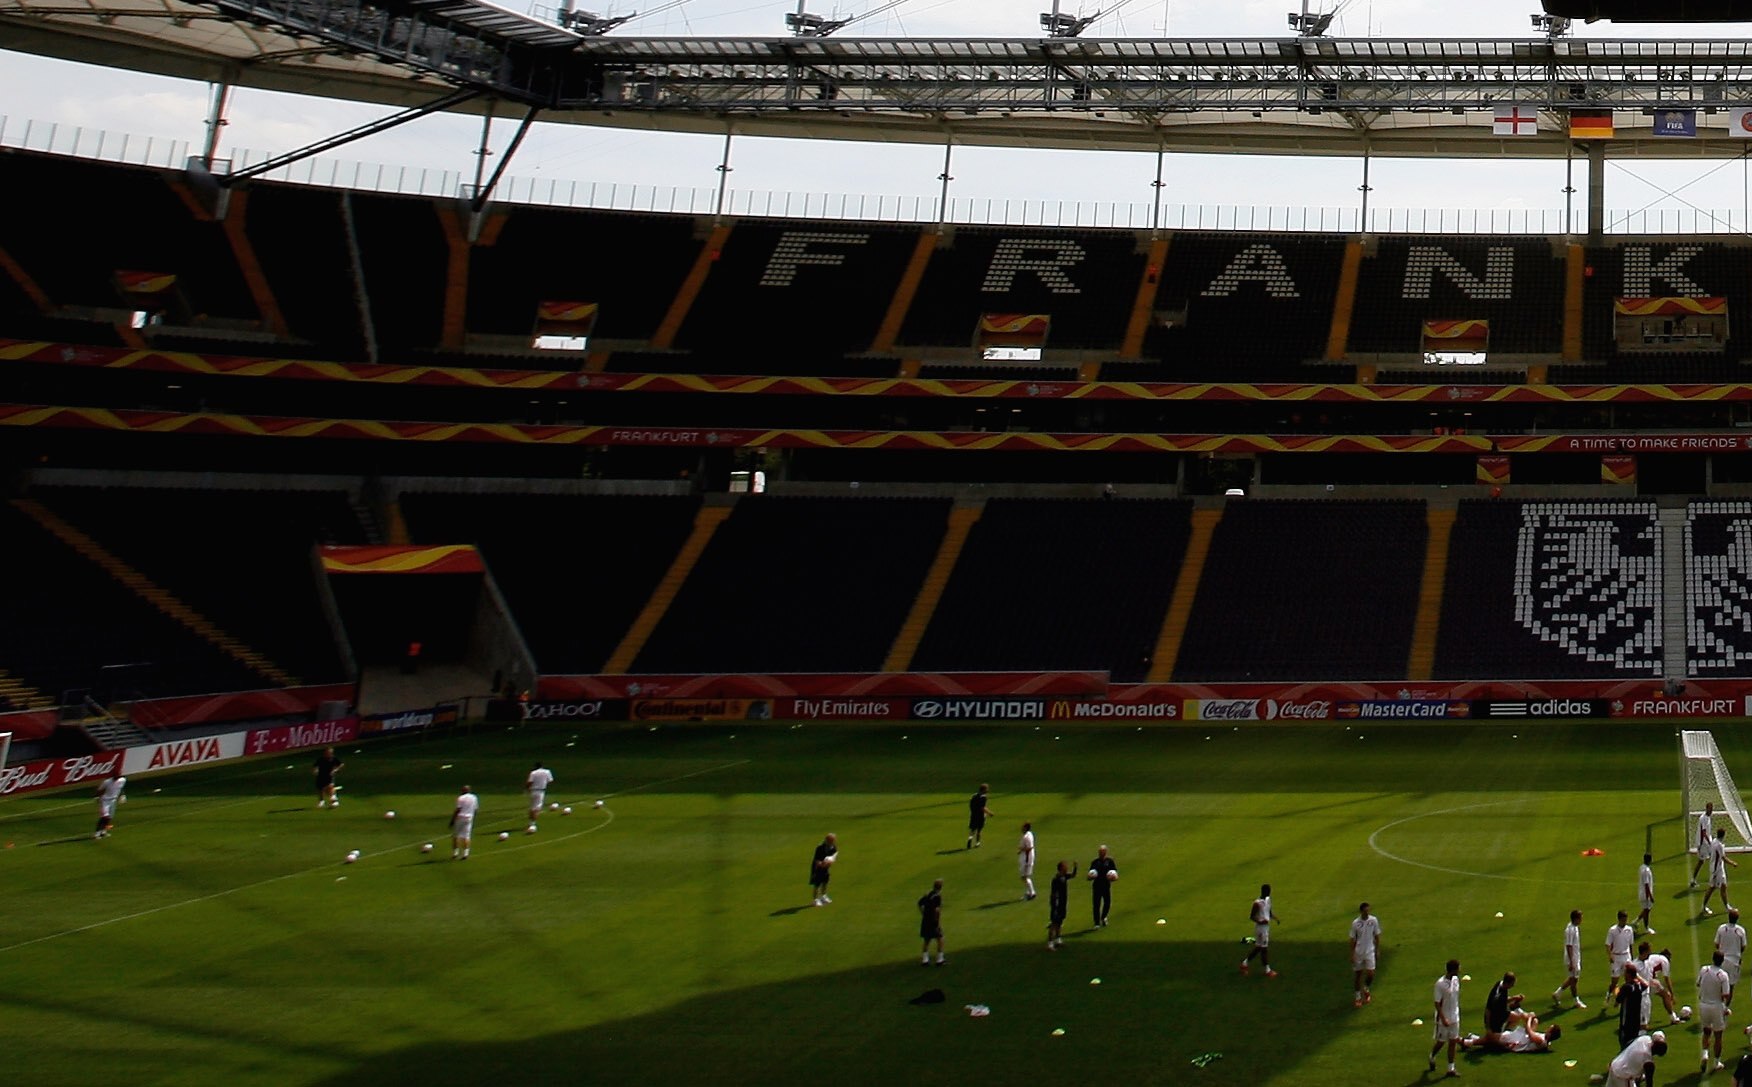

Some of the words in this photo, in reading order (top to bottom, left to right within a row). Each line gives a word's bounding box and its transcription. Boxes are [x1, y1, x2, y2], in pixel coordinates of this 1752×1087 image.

[612, 431, 699, 443] FRANKFURT
[1569, 437, 1580, 449] A
[1583, 437, 1616, 449] TIME
[1619, 437, 1637, 449] TO
[1639, 437, 1679, 449] MAKE
[1681, 437, 1738, 449] FRIENDS
[794, 700, 819, 718] Fly
[821, 700, 890, 716] Emirates
[945, 701, 1044, 718] HYUNDAI
[1074, 702, 1177, 718] McDonald's
[1360, 702, 1447, 718] MasterCard
[1530, 699, 1592, 715] adidas
[1633, 699, 1737, 715] FRANKFURT
[149, 736, 220, 770] AVAYA
[63, 753, 121, 784] Bud
[0, 762, 55, 794] Bud
